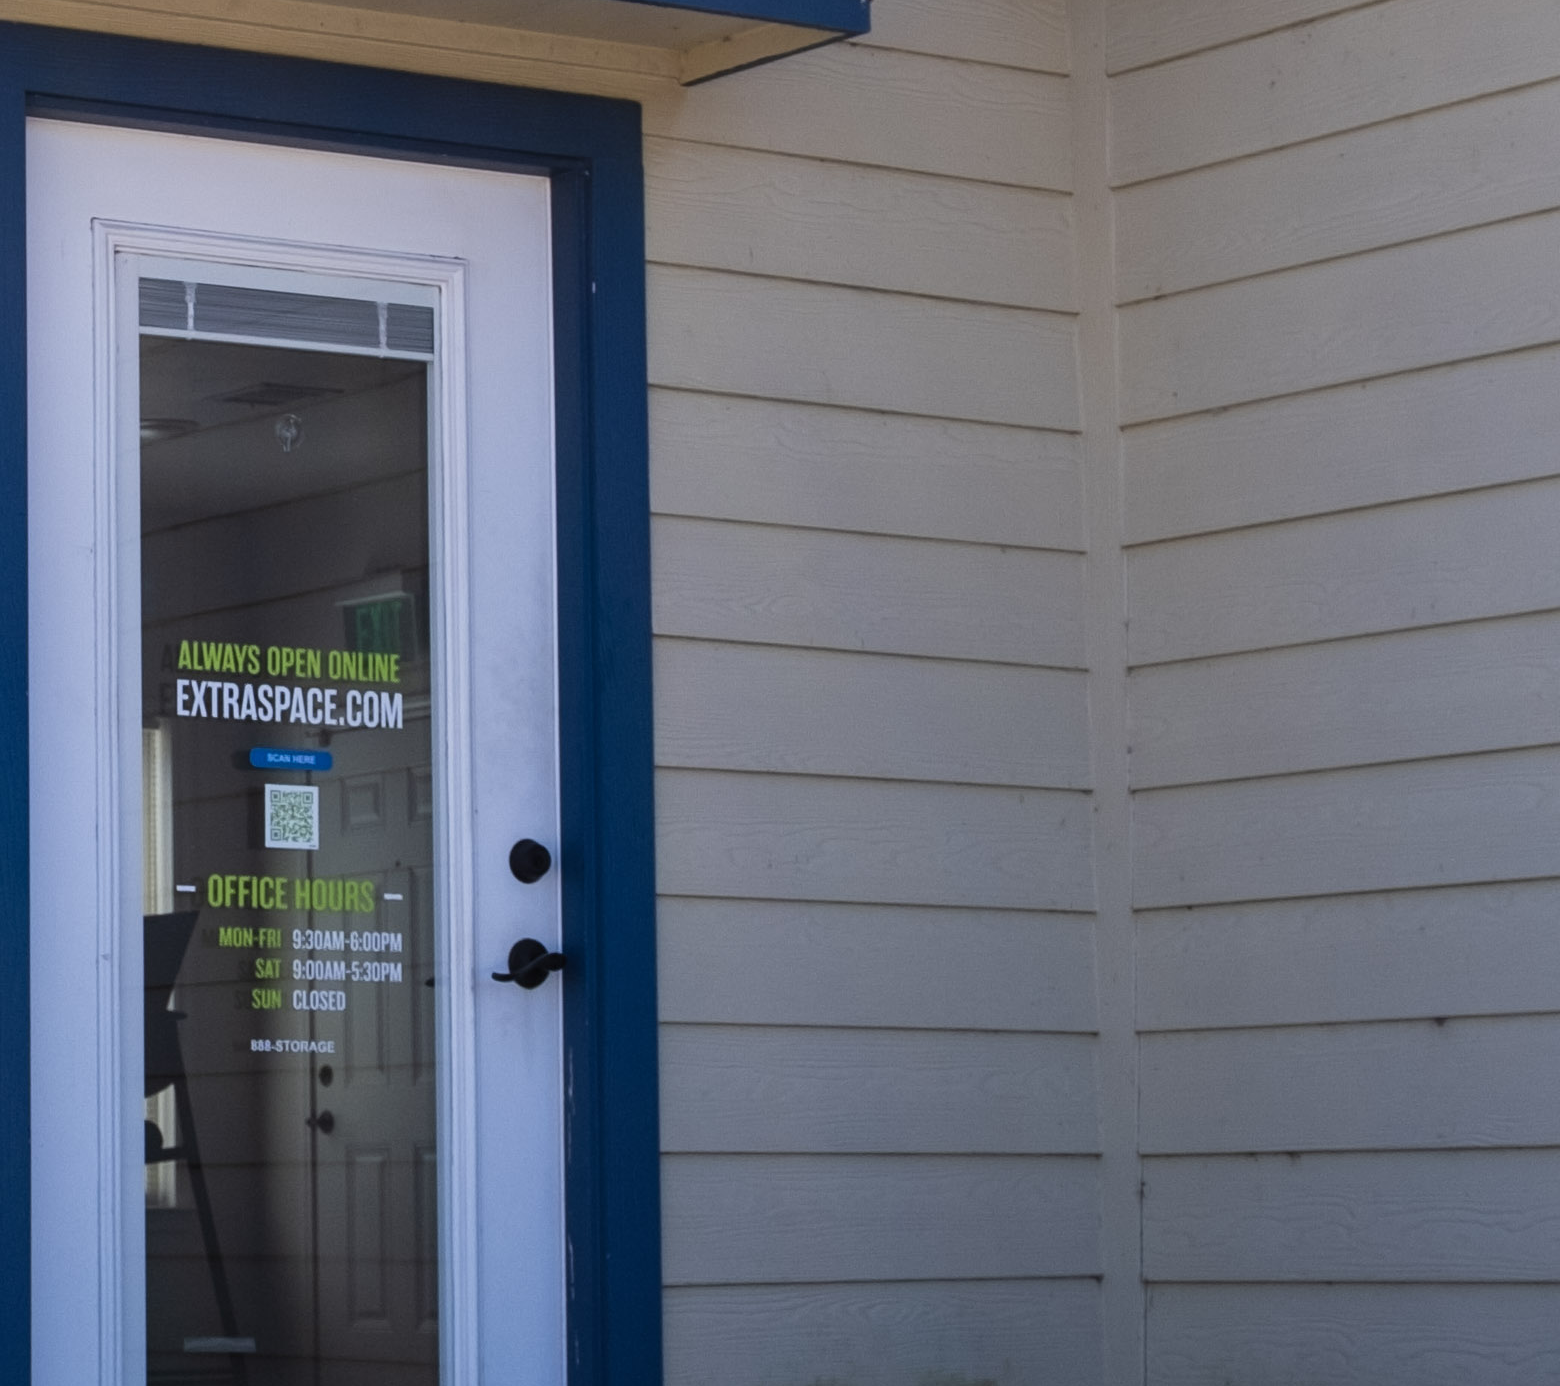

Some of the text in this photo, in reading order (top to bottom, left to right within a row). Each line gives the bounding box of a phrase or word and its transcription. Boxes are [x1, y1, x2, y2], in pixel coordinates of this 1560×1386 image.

[178, 640, 401, 684] ALWAYS OPEN ONLINE
[176, 679, 403, 729] EXTRASPACE.COM
[267, 753, 316, 765] SCAN HERE
[207, 874, 375, 912] OFFICE HOURS
[219, 927, 403, 953] MON-FRI 9:30AM-6:00PM
[255, 958, 403, 983] SAT 9:00AM-5:30PM
[252, 988, 346, 1011] SUN CLOSED
[250, 1039, 336, 1054] 888-STORAGE
